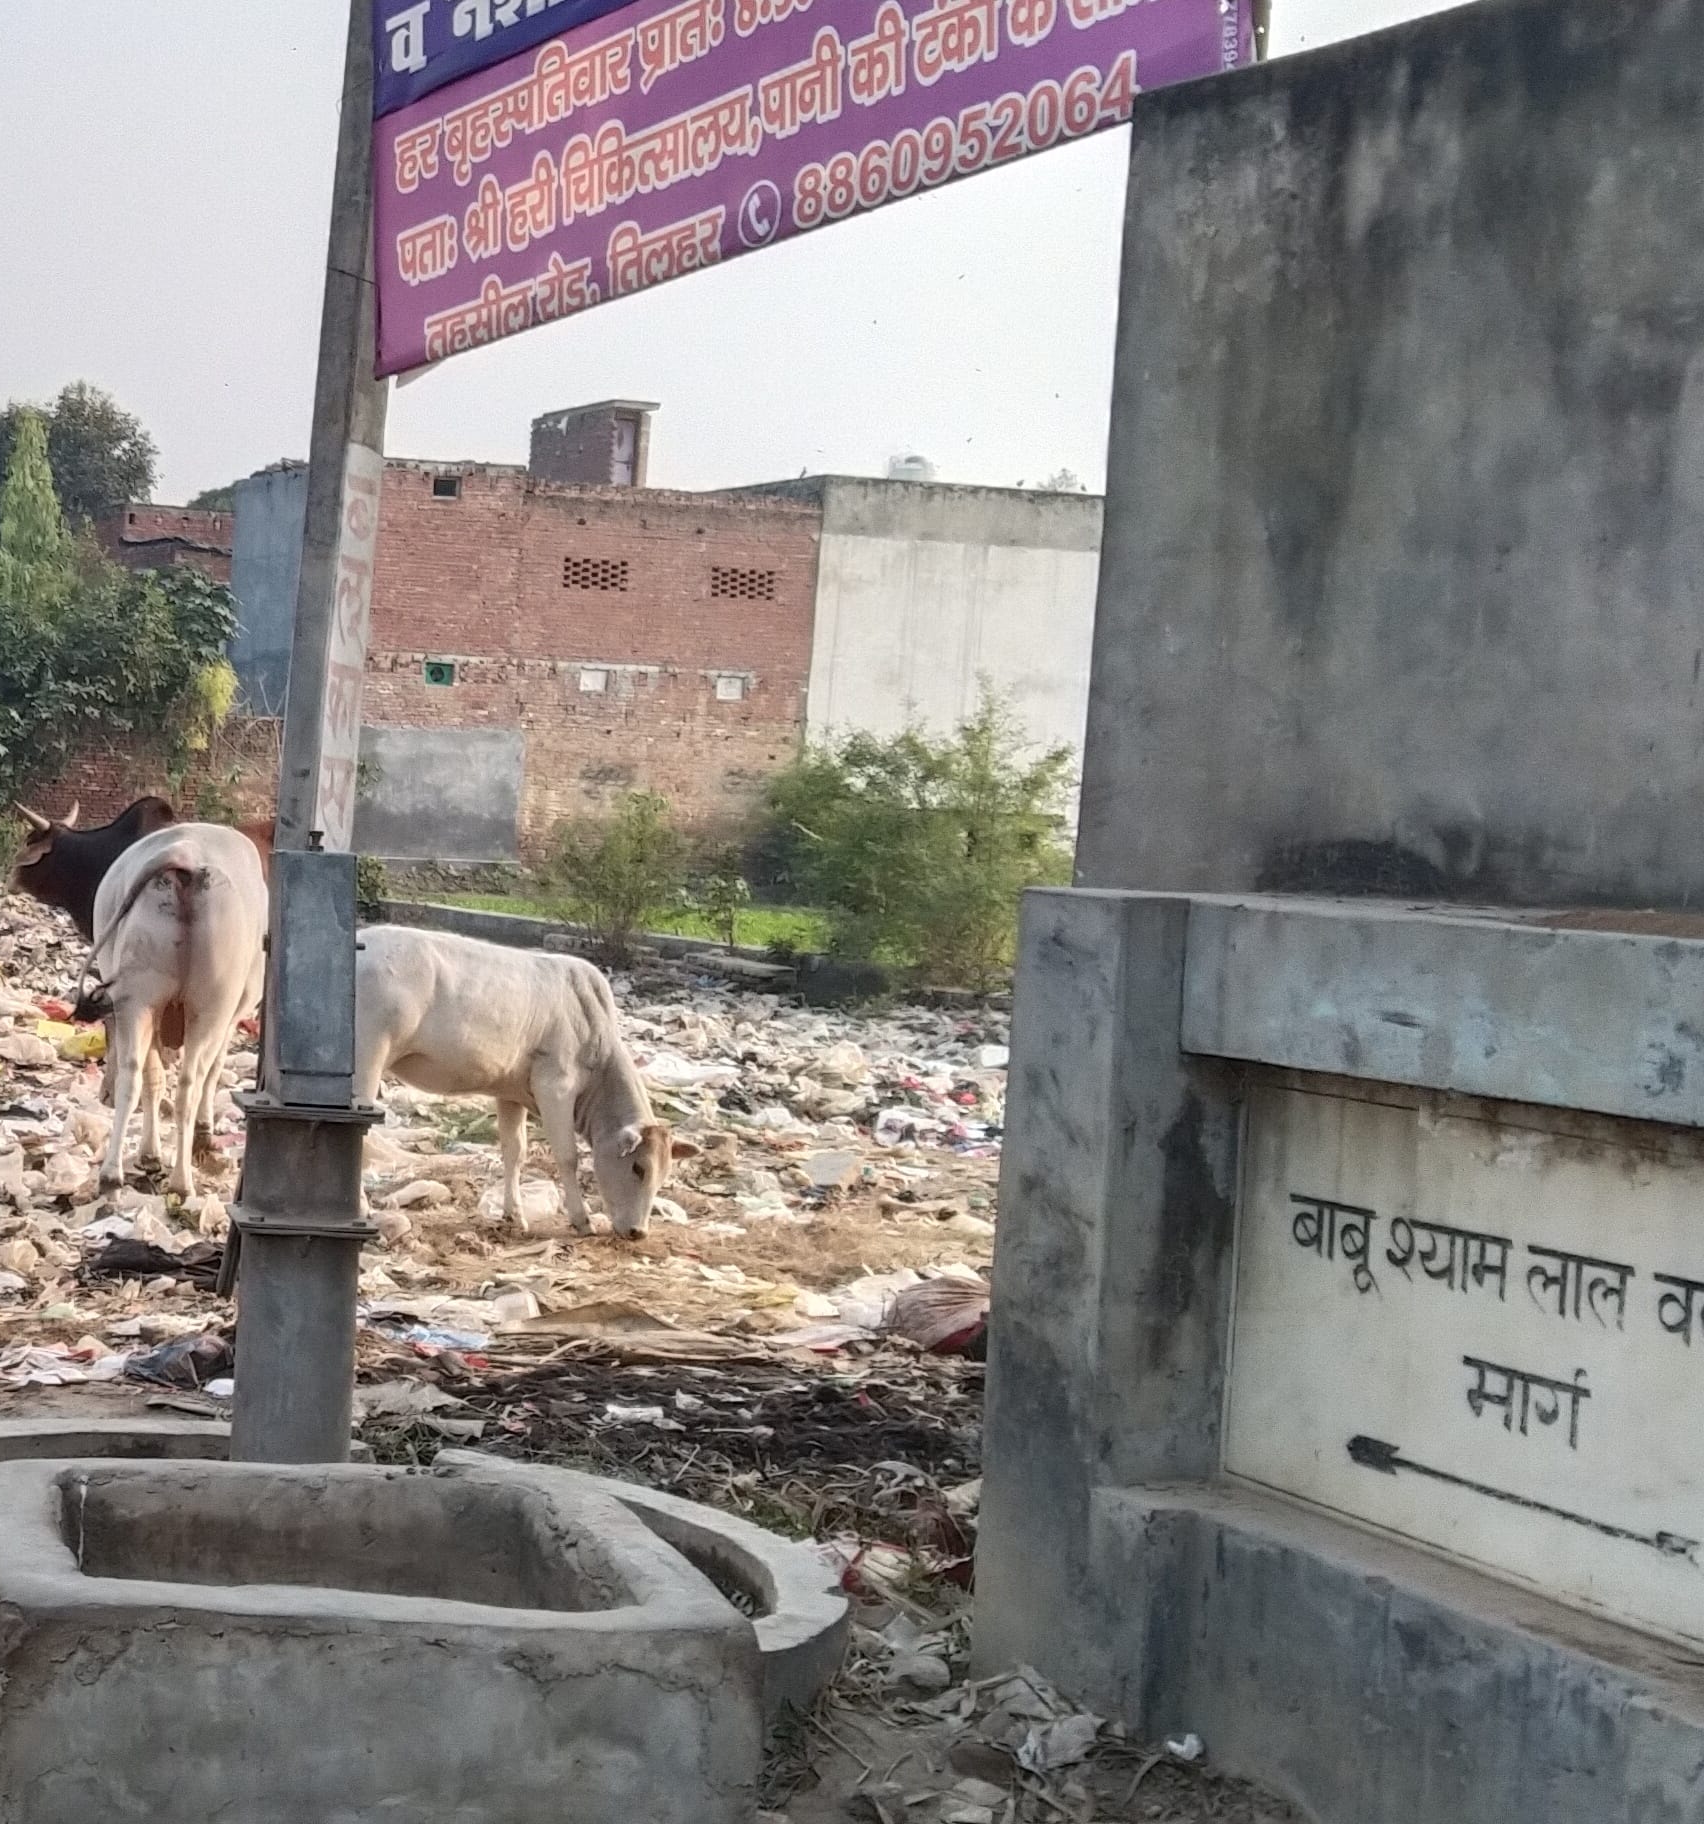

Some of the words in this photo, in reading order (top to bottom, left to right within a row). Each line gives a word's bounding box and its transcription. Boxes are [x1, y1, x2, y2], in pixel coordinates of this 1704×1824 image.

[386, 2, 430, 73] व
[395, 118, 443, 194] हर
[444, 28, 635, 186] बृहस्पतिवार
[424, 274, 537, 360] तहसील
[607, 221, 726, 298] तिलहर
[794, 49, 1140, 229] 8860952064
[463, 173, 504, 262] श्री
[505, 151, 557, 252] हरी
[848, 0, 910, 106] की
[1290, 1193, 1382, 1298] बाबू
[1386, 1216, 1513, 1301] श्याम
[1527, 1245, 1635, 1330] लाल
[1463, 1355, 1592, 1450] मार्ग
